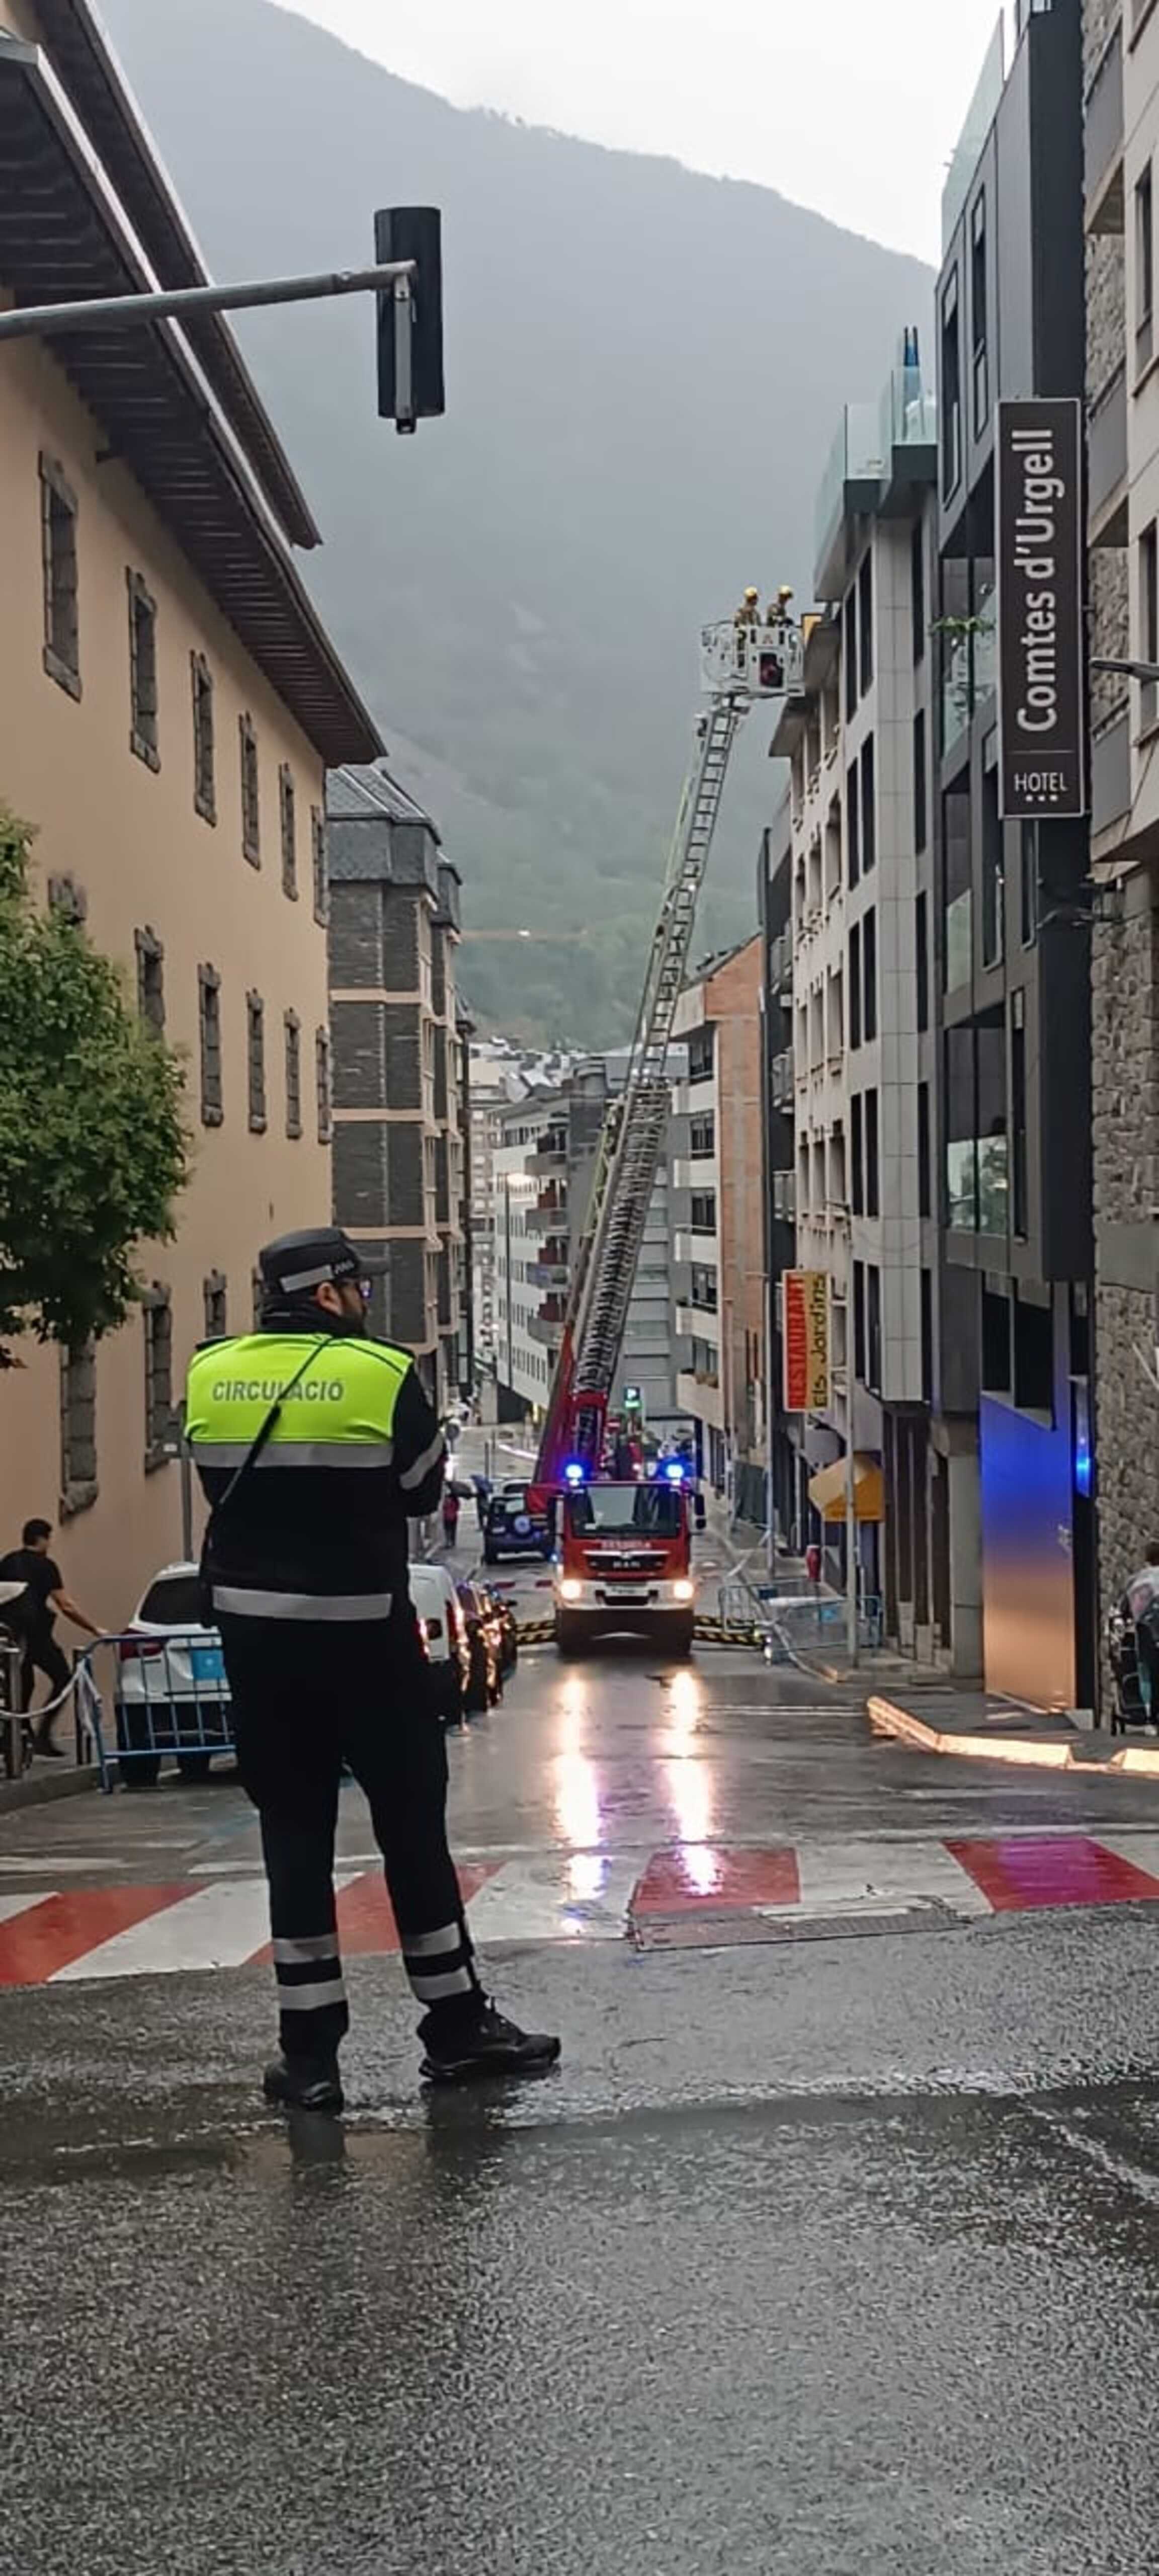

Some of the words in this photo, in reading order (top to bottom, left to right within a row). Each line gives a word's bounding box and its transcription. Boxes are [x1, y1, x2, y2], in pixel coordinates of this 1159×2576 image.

[1012, 429, 1064, 579] d'Urgell
[1017, 591, 1057, 732] Comtes
[1015, 772, 1067, 792] HOTEL
[787, 1276, 806, 1407] RESTAURANT
[809, 1274, 827, 1364] Jardins
[213, 1378, 344, 1402] CIRCULACIÓ
[811, 1376, 827, 1408] Els
